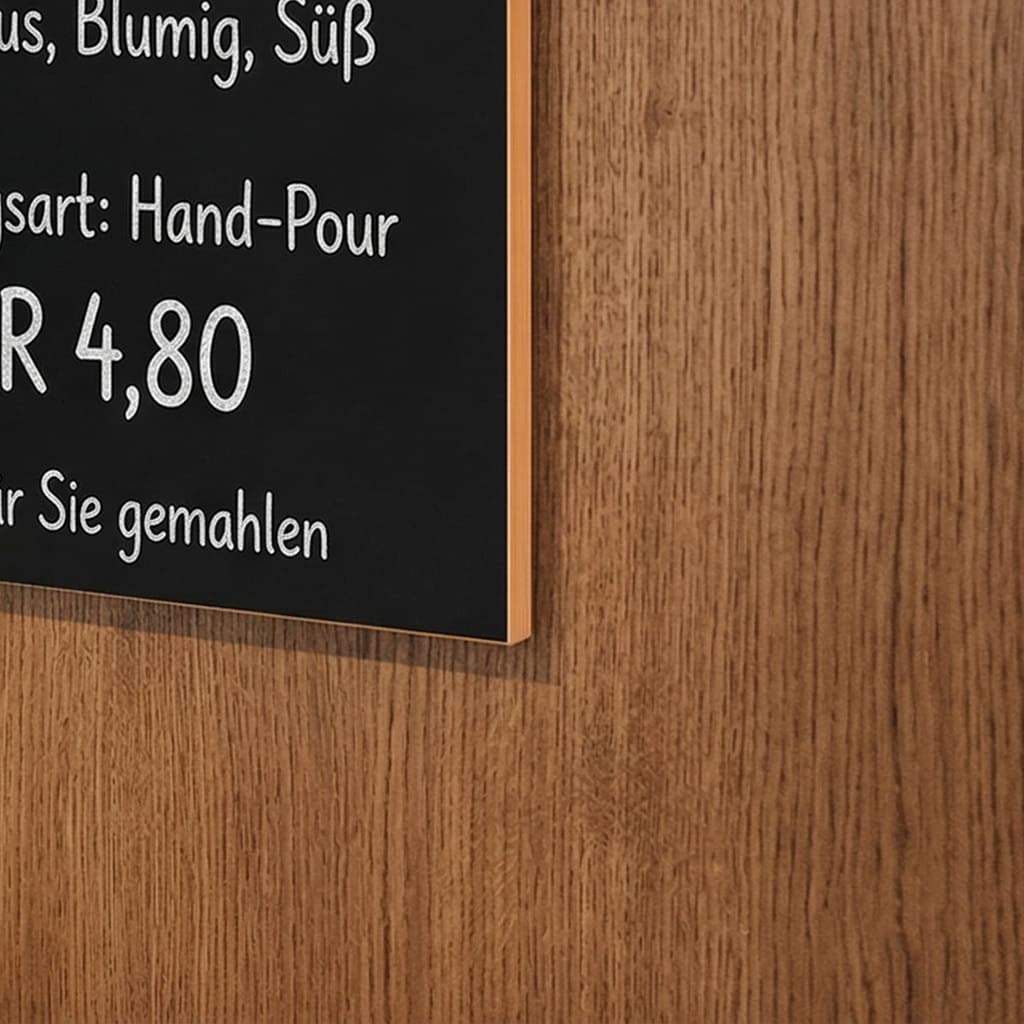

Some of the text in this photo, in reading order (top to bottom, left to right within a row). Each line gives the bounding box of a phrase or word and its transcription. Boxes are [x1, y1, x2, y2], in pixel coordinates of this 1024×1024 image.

[131, 172, 399, 258] Hand-Pour
[74, 291, 252, 421] 4,80
[38, 469, 103, 536] Sie
[118, 488, 329, 564] gemahlen
